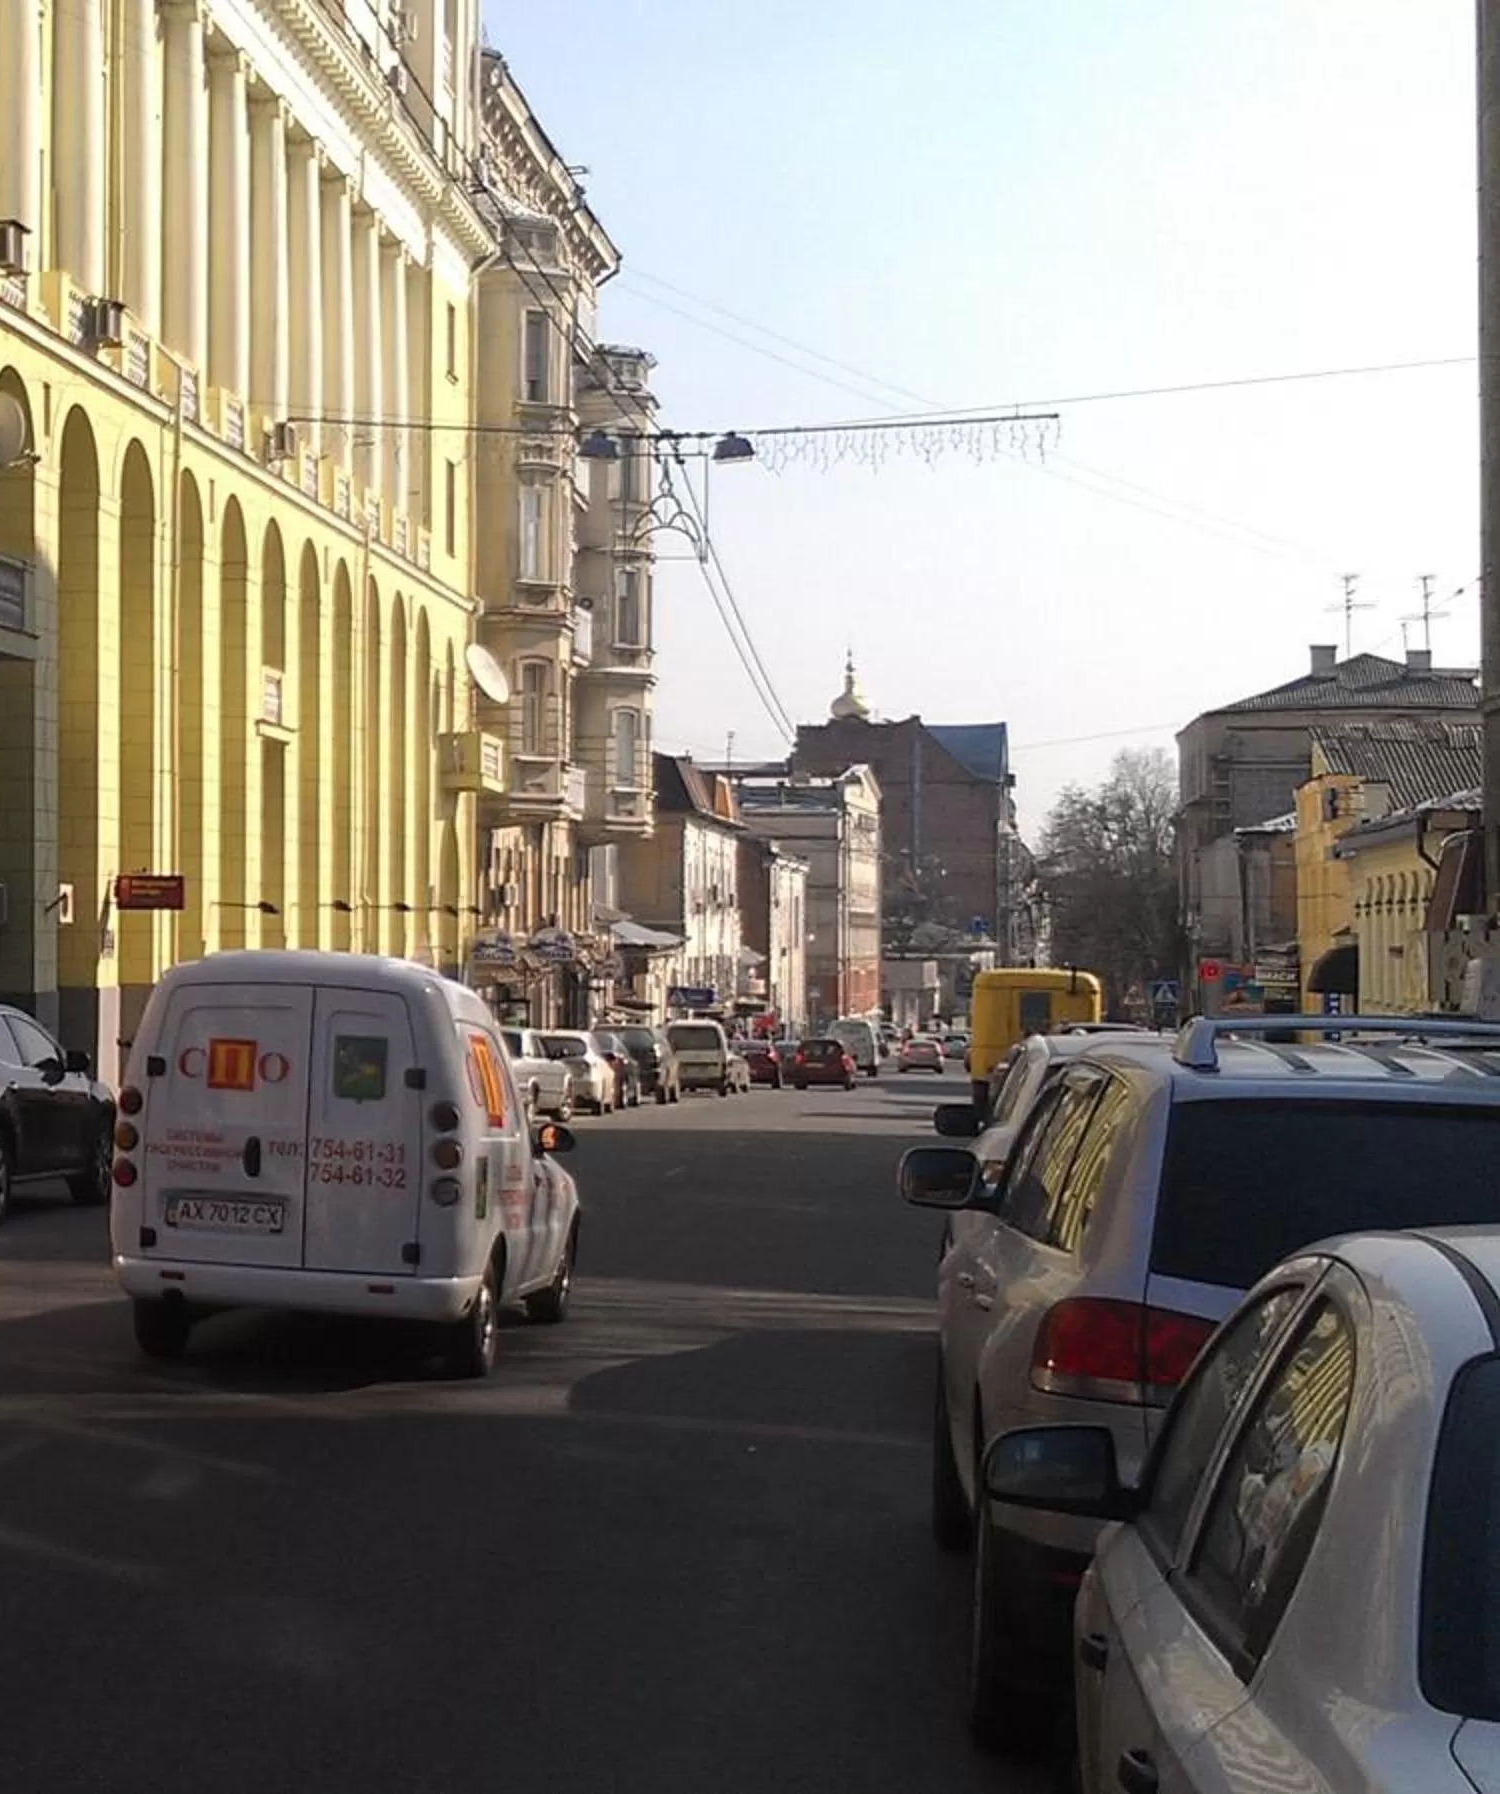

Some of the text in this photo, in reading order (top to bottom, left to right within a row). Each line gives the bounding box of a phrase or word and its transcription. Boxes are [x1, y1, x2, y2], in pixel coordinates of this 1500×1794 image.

[312, 1137, 405, 1163] 754-61-31
[311, 1162, 406, 1189] 754-61-32
[209, 1205, 250, 1224] 7012
